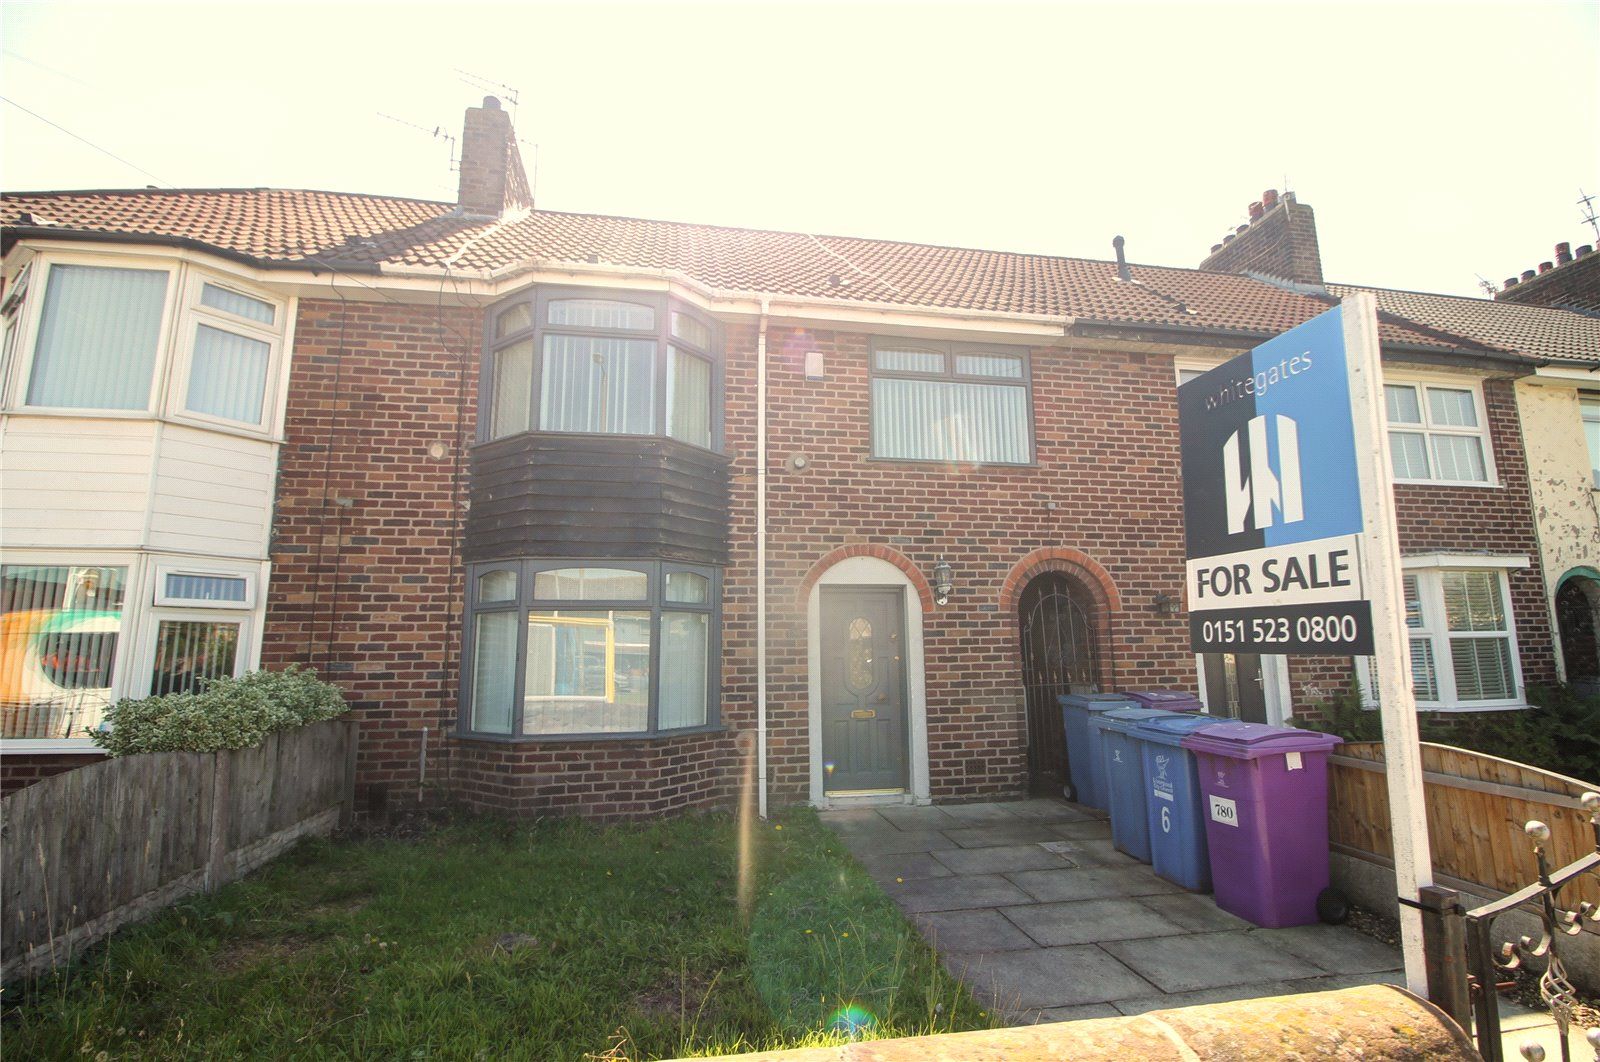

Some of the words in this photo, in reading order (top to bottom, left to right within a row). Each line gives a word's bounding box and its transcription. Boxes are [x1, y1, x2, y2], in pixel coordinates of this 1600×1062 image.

[1205, 350, 1313, 411] whitegates
[1197, 563, 1253, 599] FOR
[1261, 549, 1351, 593] SALE
[1202, 619, 1246, 643] 0151
[1252, 617, 1290, 643] 523
[1296, 614, 1357, 643] 0800
[1161, 806, 1171, 834] 6
[1214, 803, 1234, 819] 780
